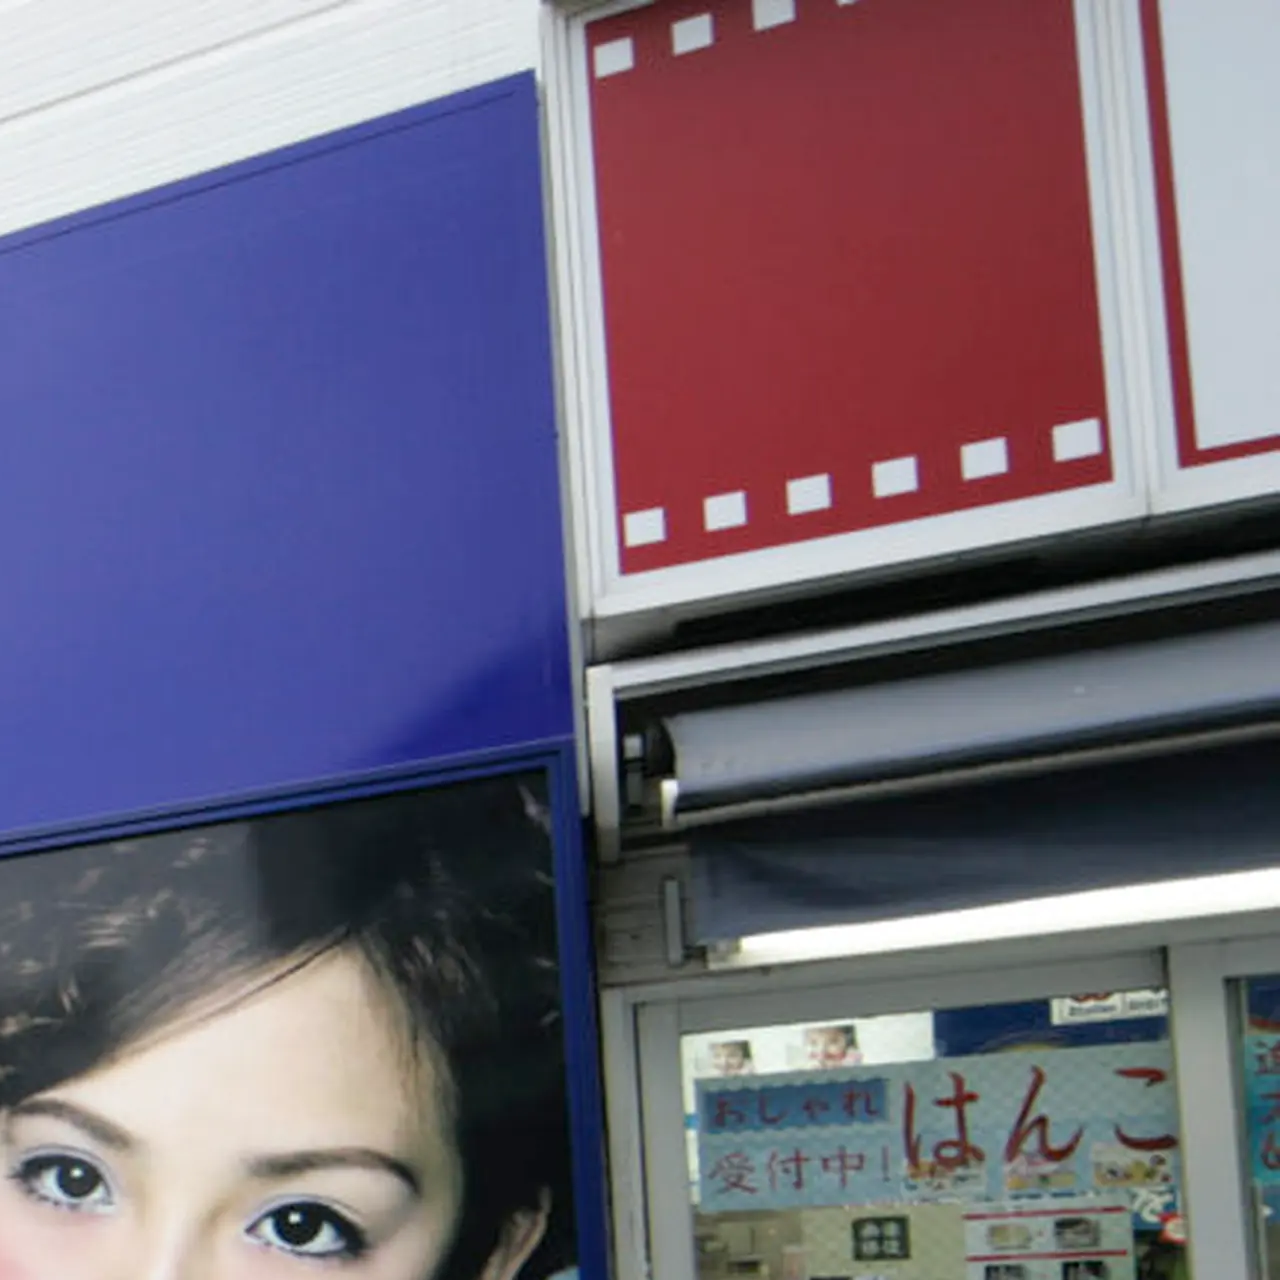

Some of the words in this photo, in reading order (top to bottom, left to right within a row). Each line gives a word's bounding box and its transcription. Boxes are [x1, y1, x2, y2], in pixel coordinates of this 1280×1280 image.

[713, 1085, 879, 1128] おしゃれ
[903, 1065, 1179, 1168] はんこ
